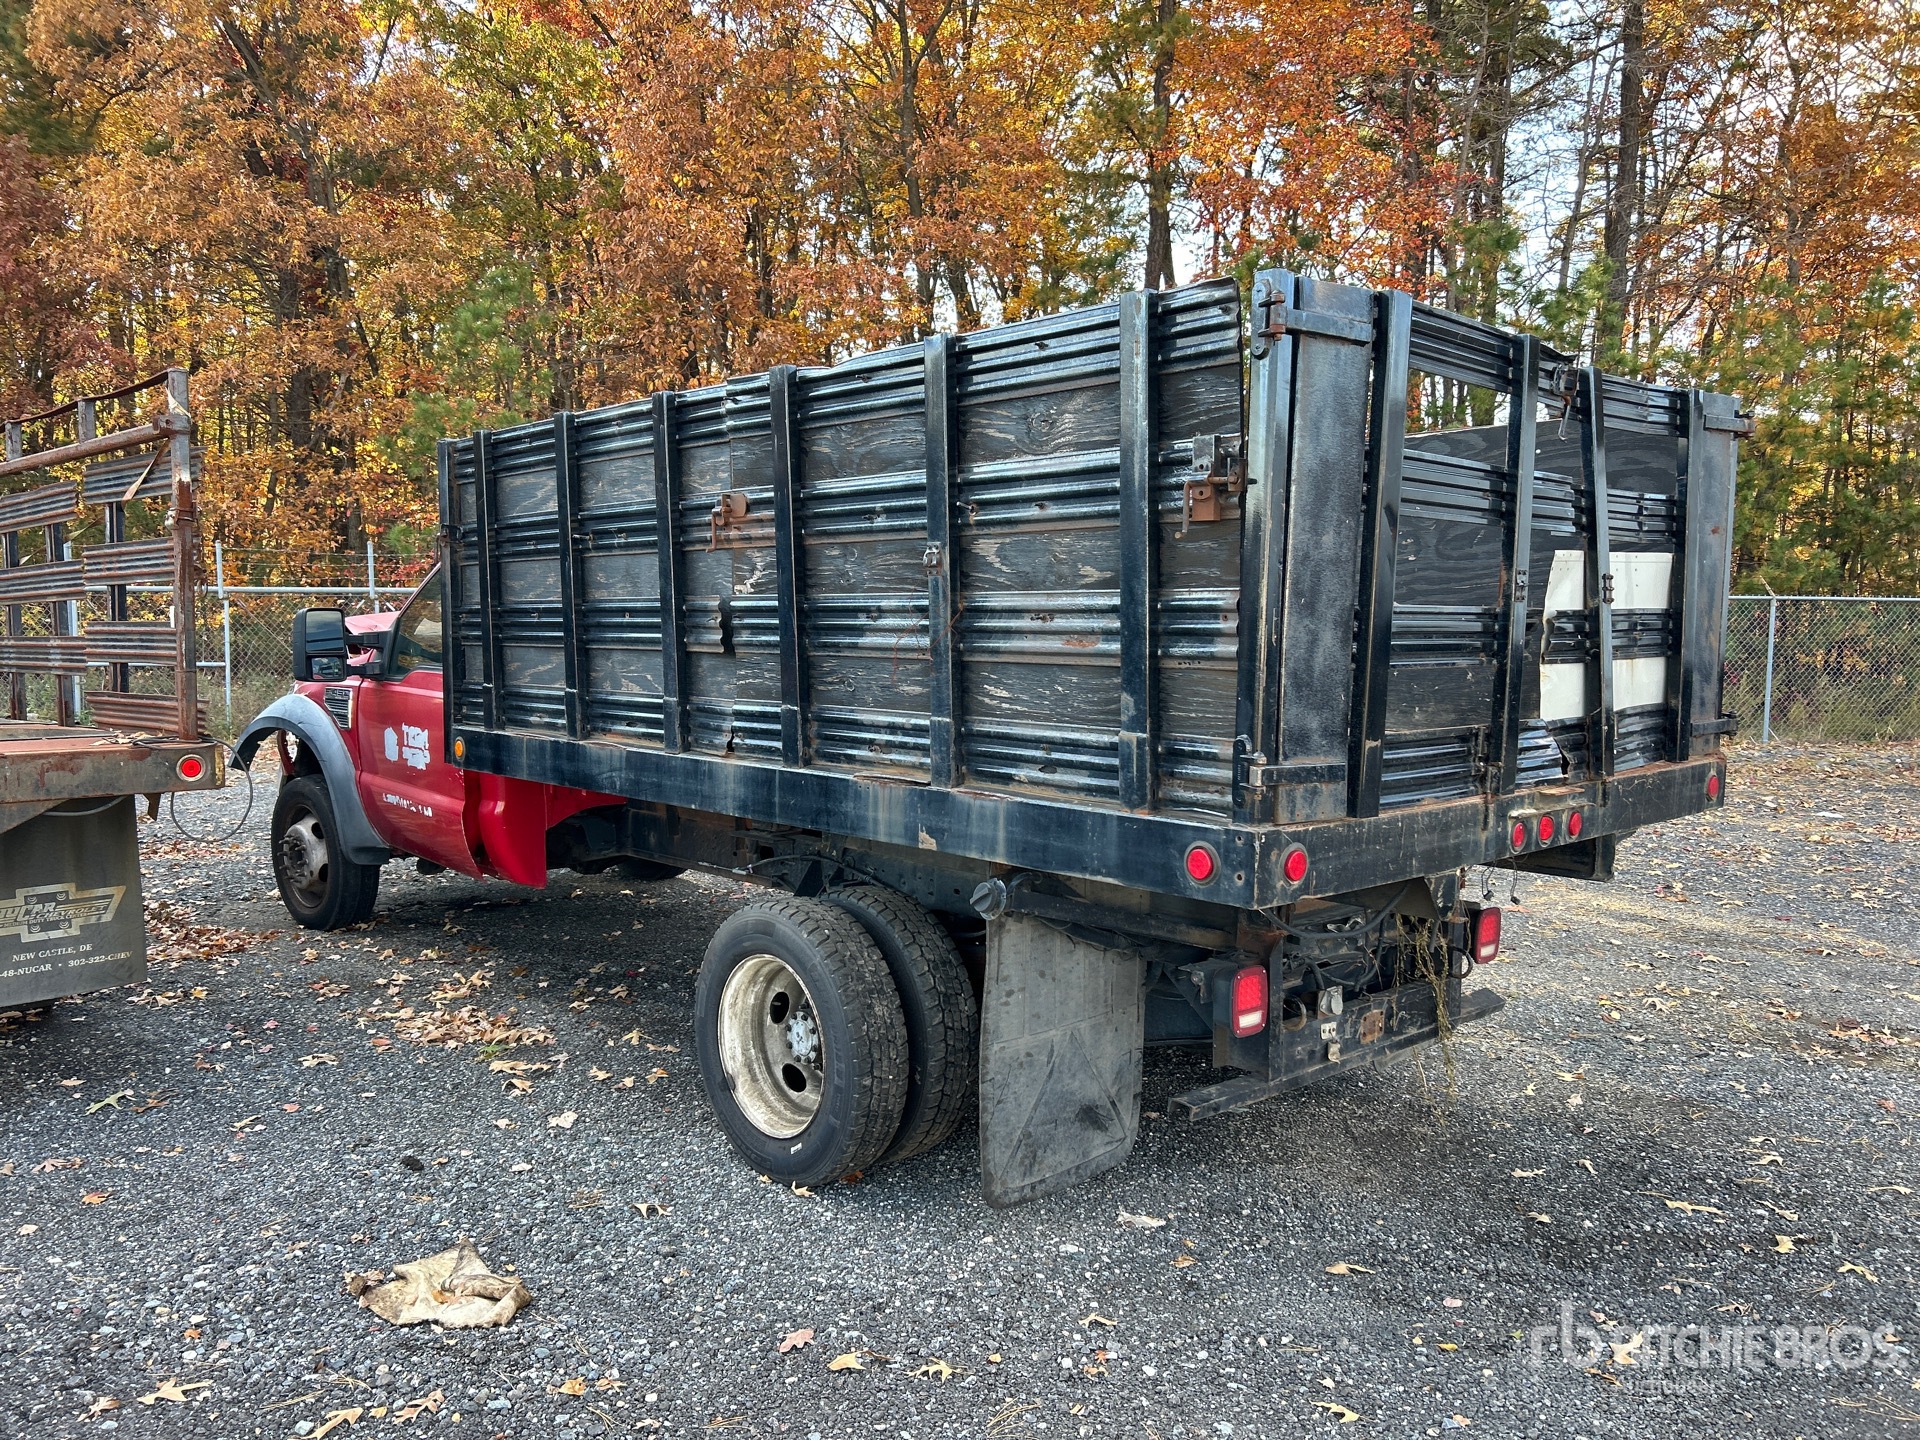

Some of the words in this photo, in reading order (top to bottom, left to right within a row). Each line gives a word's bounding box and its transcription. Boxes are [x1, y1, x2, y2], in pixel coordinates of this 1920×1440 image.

[12, 951, 36, 962] NEW
[38, 946, 77, 959] CASTLE,
[79, 943, 93, 952] DE
[68, 950, 133, 967] 302-322-CHEV
